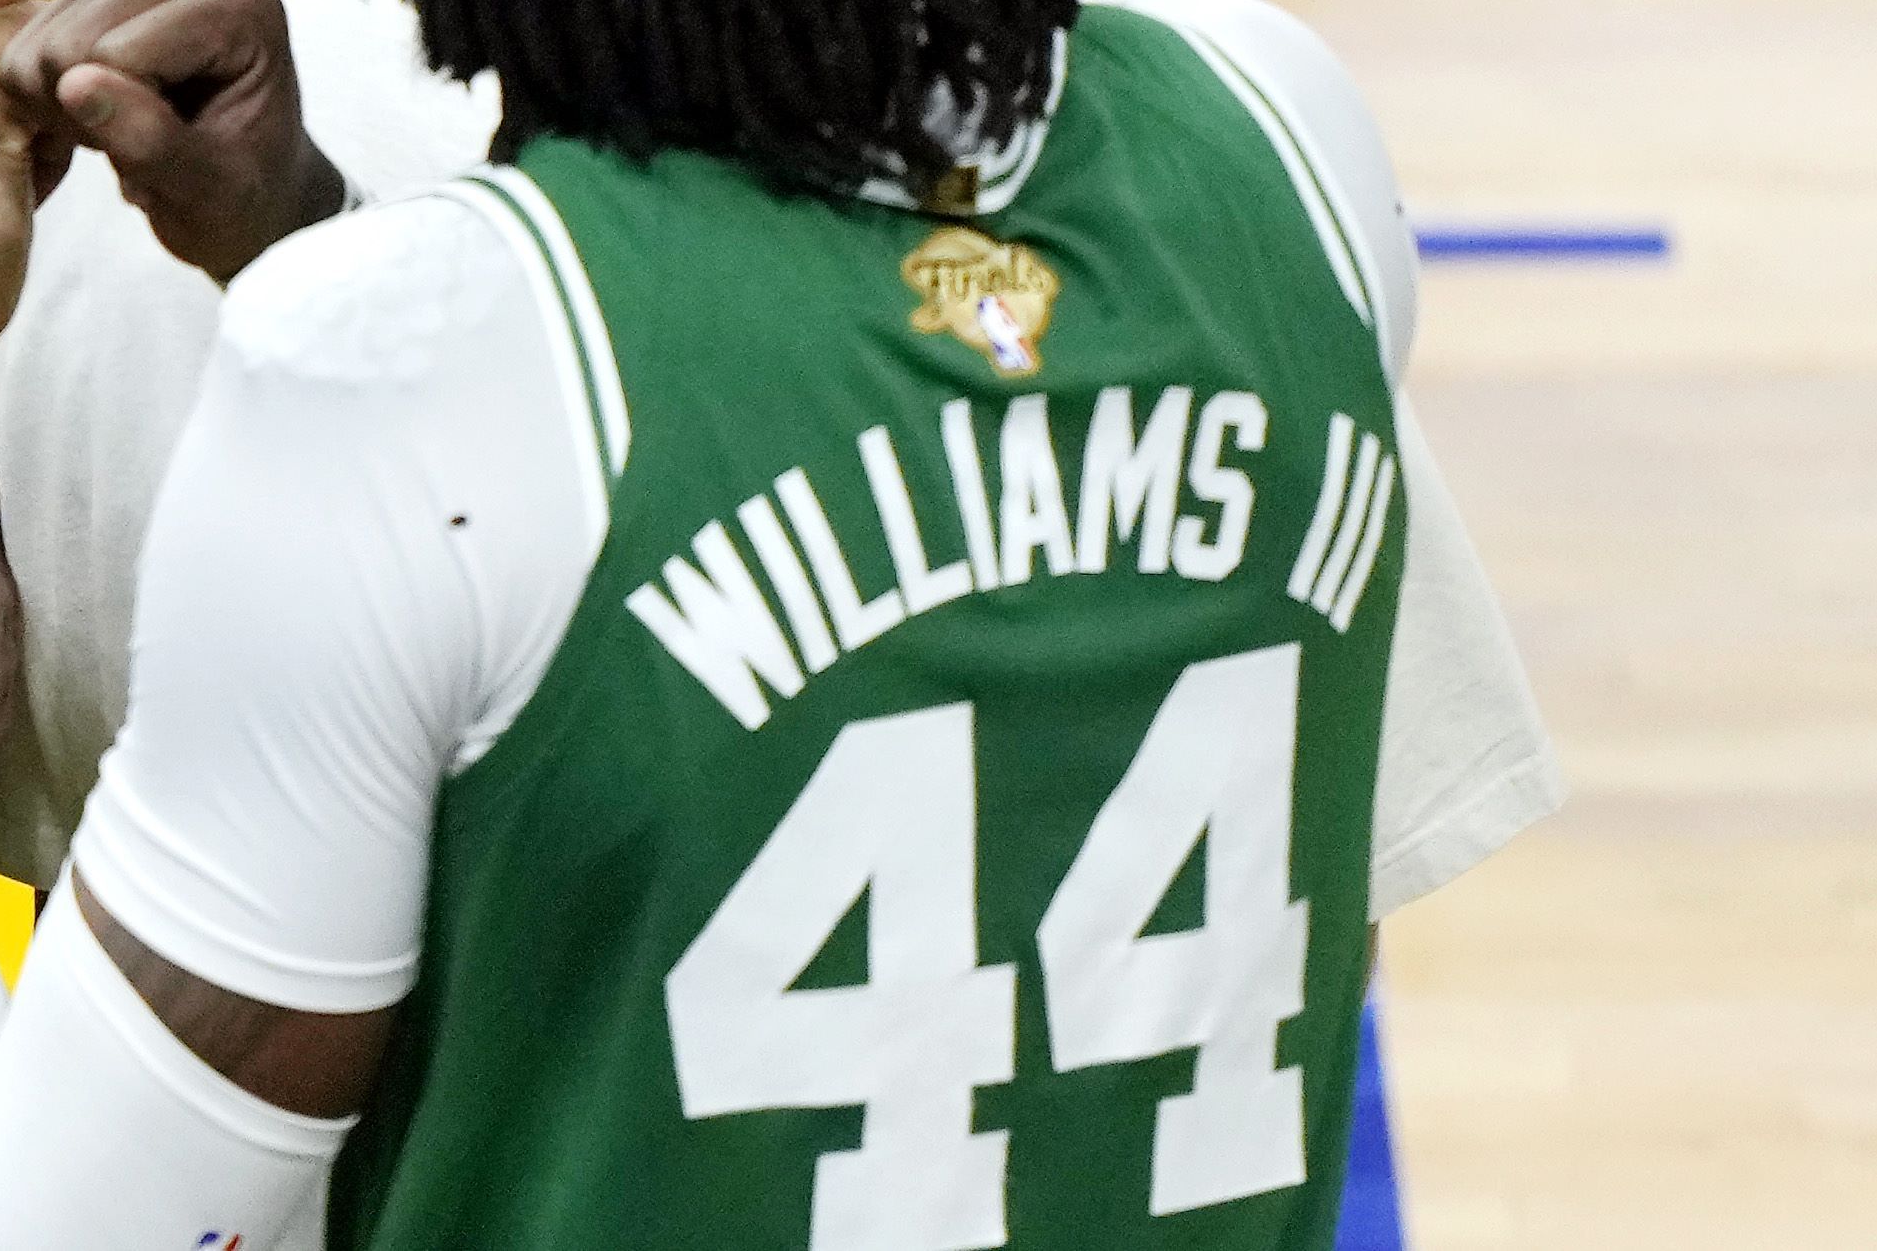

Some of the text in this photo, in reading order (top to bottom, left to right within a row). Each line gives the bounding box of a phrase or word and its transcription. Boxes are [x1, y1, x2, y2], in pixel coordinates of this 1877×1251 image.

[625, 387, 1396, 732] WILLIAMS III
[664, 642, 1309, 1251] 44
